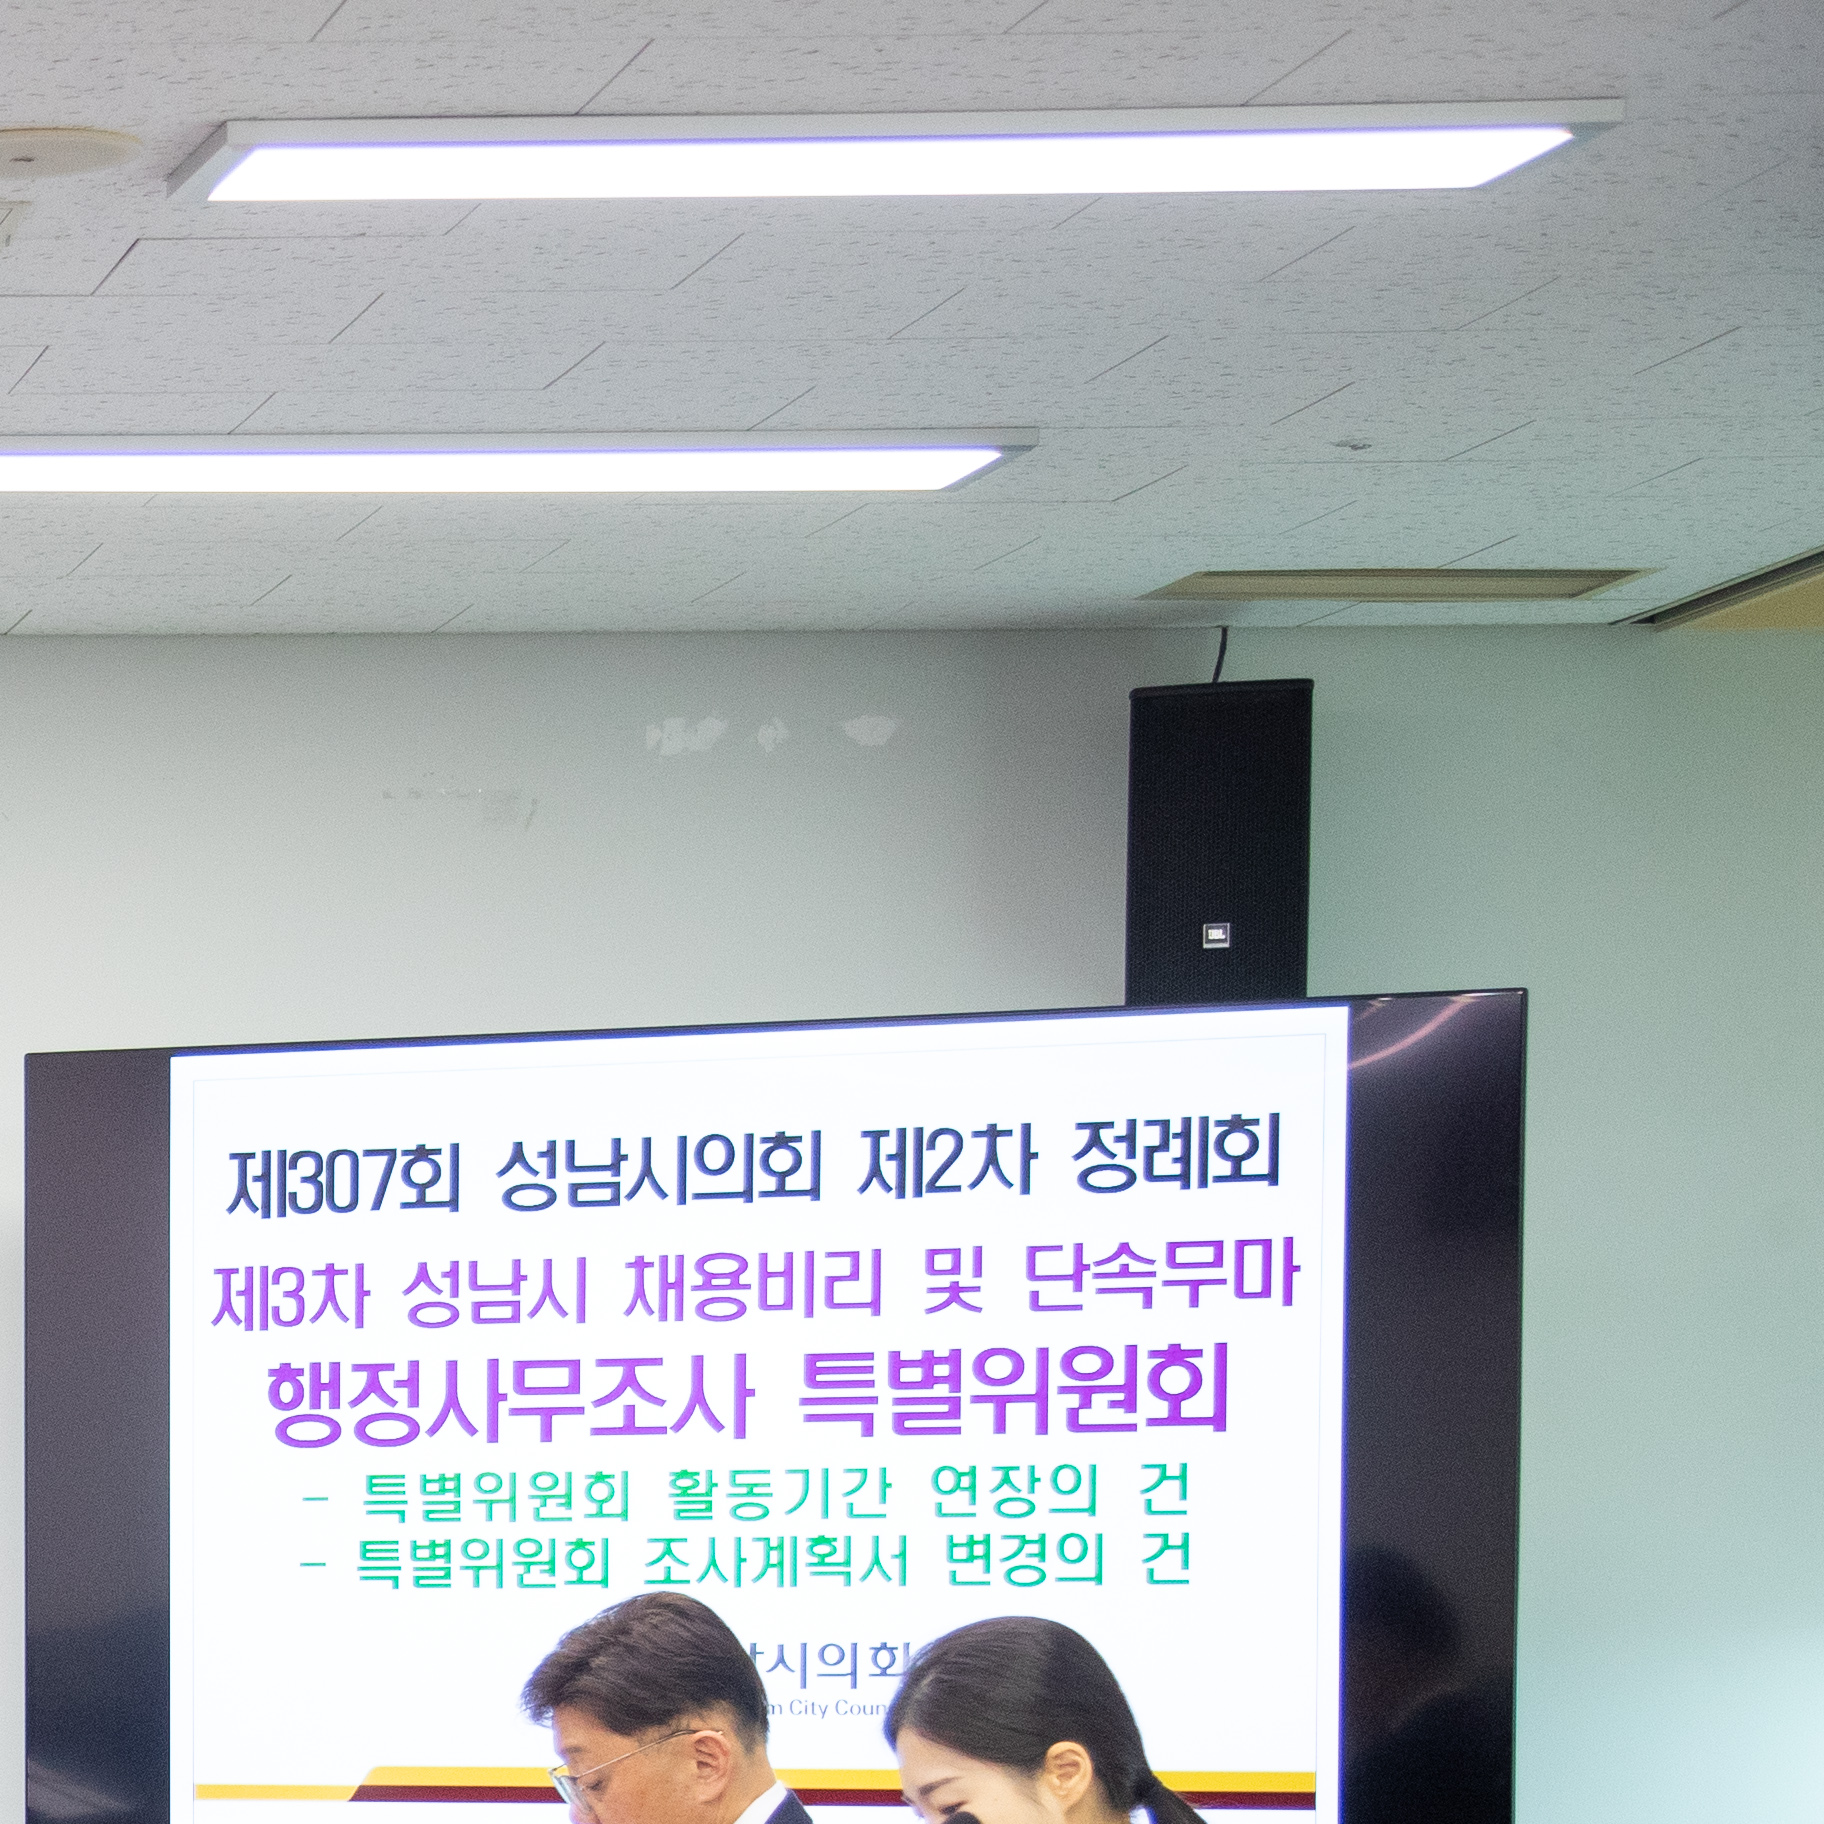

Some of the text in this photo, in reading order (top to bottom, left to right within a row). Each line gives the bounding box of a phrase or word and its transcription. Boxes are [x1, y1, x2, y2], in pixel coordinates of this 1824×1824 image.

[226, 1112, 1280, 1219] 제307회 성남시의회 제2차 정례회
[211, 1237, 1301, 1331] 제3차 성남시 채용비리 및 단속무마
[268, 1342, 1227, 1448] 행정사무조사 특별위원회
[364, 1471, 628, 1523] 특별위원회
[669, 1467, 892, 1521] 활동기간
[932, 1464, 1096, 1519] 연장의
[1140, 1463, 1187, 1515] 건
[357, 1538, 608, 1589] 특별위원회
[644, 1535, 906, 1589] 조사계획서
[947, 1533, 1103, 1587] 변경의
[1142, 1532, 1189, 1585] 건
[749, 1642, 910, 1689] 시의회
[789, 1699, 829, 1719] City
[835, 1699, 887, 1716] Coun
